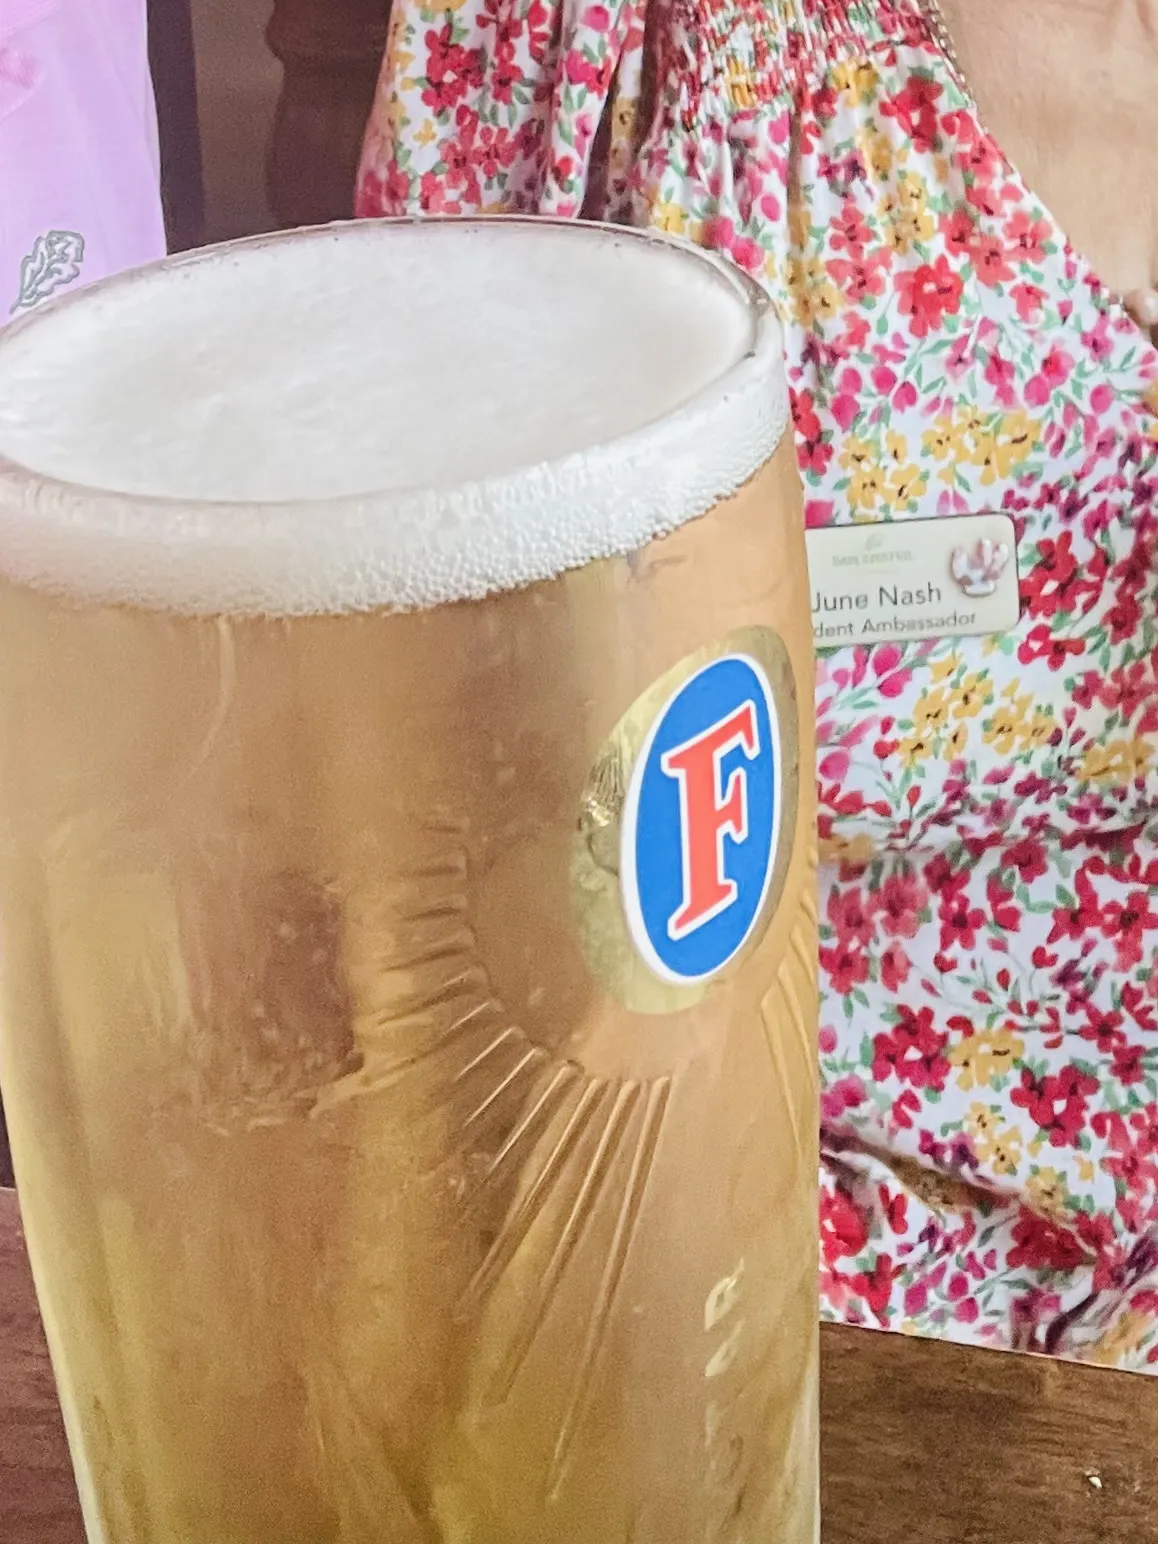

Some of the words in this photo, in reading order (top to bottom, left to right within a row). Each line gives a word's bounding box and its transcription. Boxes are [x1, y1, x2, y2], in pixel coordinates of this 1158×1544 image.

[812, 591, 868, 613] June
[879, 581, 942, 607] Nash
[861, 611, 977, 634] Ambassador
[661, 699, 760, 941] F
